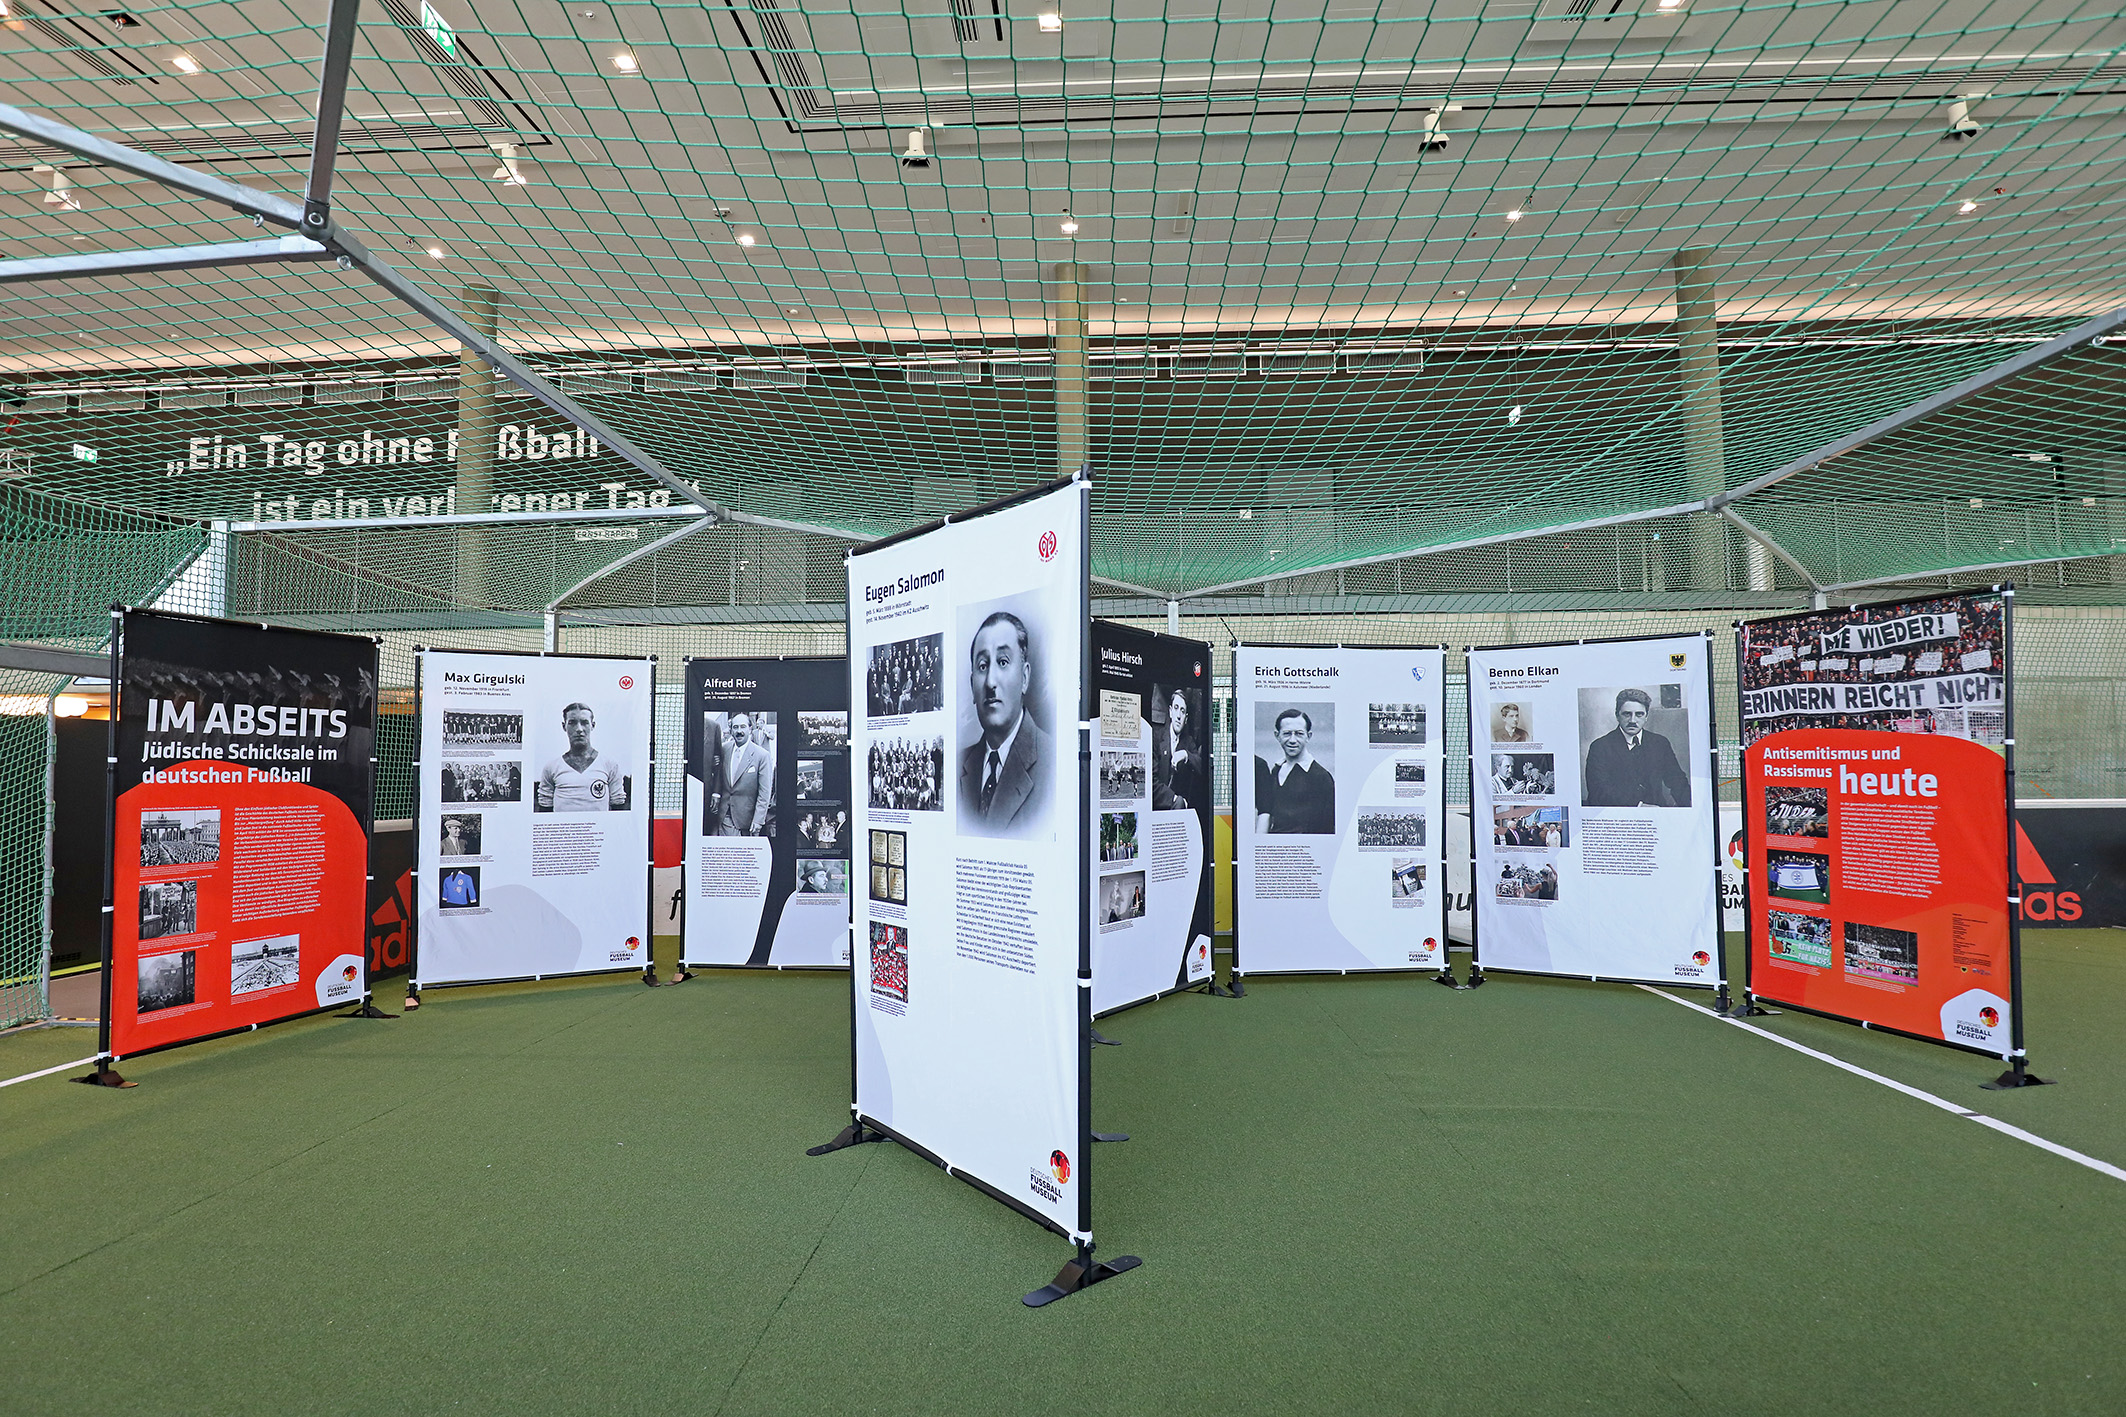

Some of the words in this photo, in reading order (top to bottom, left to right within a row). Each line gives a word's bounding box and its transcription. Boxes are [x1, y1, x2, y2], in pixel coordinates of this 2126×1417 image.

[166, 435, 247, 477] „Ein
[260, 434, 327, 476] Tag
[337, 430, 434, 466] ohne
[253, 491, 300, 522] ist
[311, 489, 370, 520] ein
[866, 584, 895, 604] Eugen
[897, 568, 944, 595] Salomon
[1857, 616, 1945, 649] WIEDER!
[1101, 646, 1121, 662] Julius
[1121, 651, 1143, 666] Hirsch
[445, 672, 470, 683] Max
[473, 673, 525, 686] Girgulski
[1255, 666, 1281, 677] Erich
[1283, 667, 1339, 677] Gottschalk
[1489, 668, 1524, 678] Benno
[1527, 665, 1559, 676] Elkan
[704, 678, 734, 688] Alfred
[736, 678, 757, 688] Ries
[1744, 686, 1836, 716] ERINNERN
[1846, 683, 1925, 709] REICHT
[1936, 676, 2003, 704] NICHT
[147, 697, 195, 734] IM
[202, 702, 348, 739] ABSEITS
[141, 741, 223, 763] Jüdische
[228, 743, 314, 762] Schicksale
[318, 744, 338, 762] im
[1763, 746, 1868, 761] Antisemitismus
[1872, 746, 1901, 761] und
[142, 766, 243, 784] deutschen
[247, 767, 312, 784] Fußball
[1764, 764, 1833, 778] Rassismus
[1839, 764, 1939, 797] heute
[327, 984, 351, 993] FUSSBALL
[1956, 1023, 1992, 1037] FUSSBALL
[1956, 1029, 1986, 1041] MUSEUM
[1030, 1173, 1063, 1199] FUSSBALL
[1030, 1182, 1058, 1205] MUSEUM
